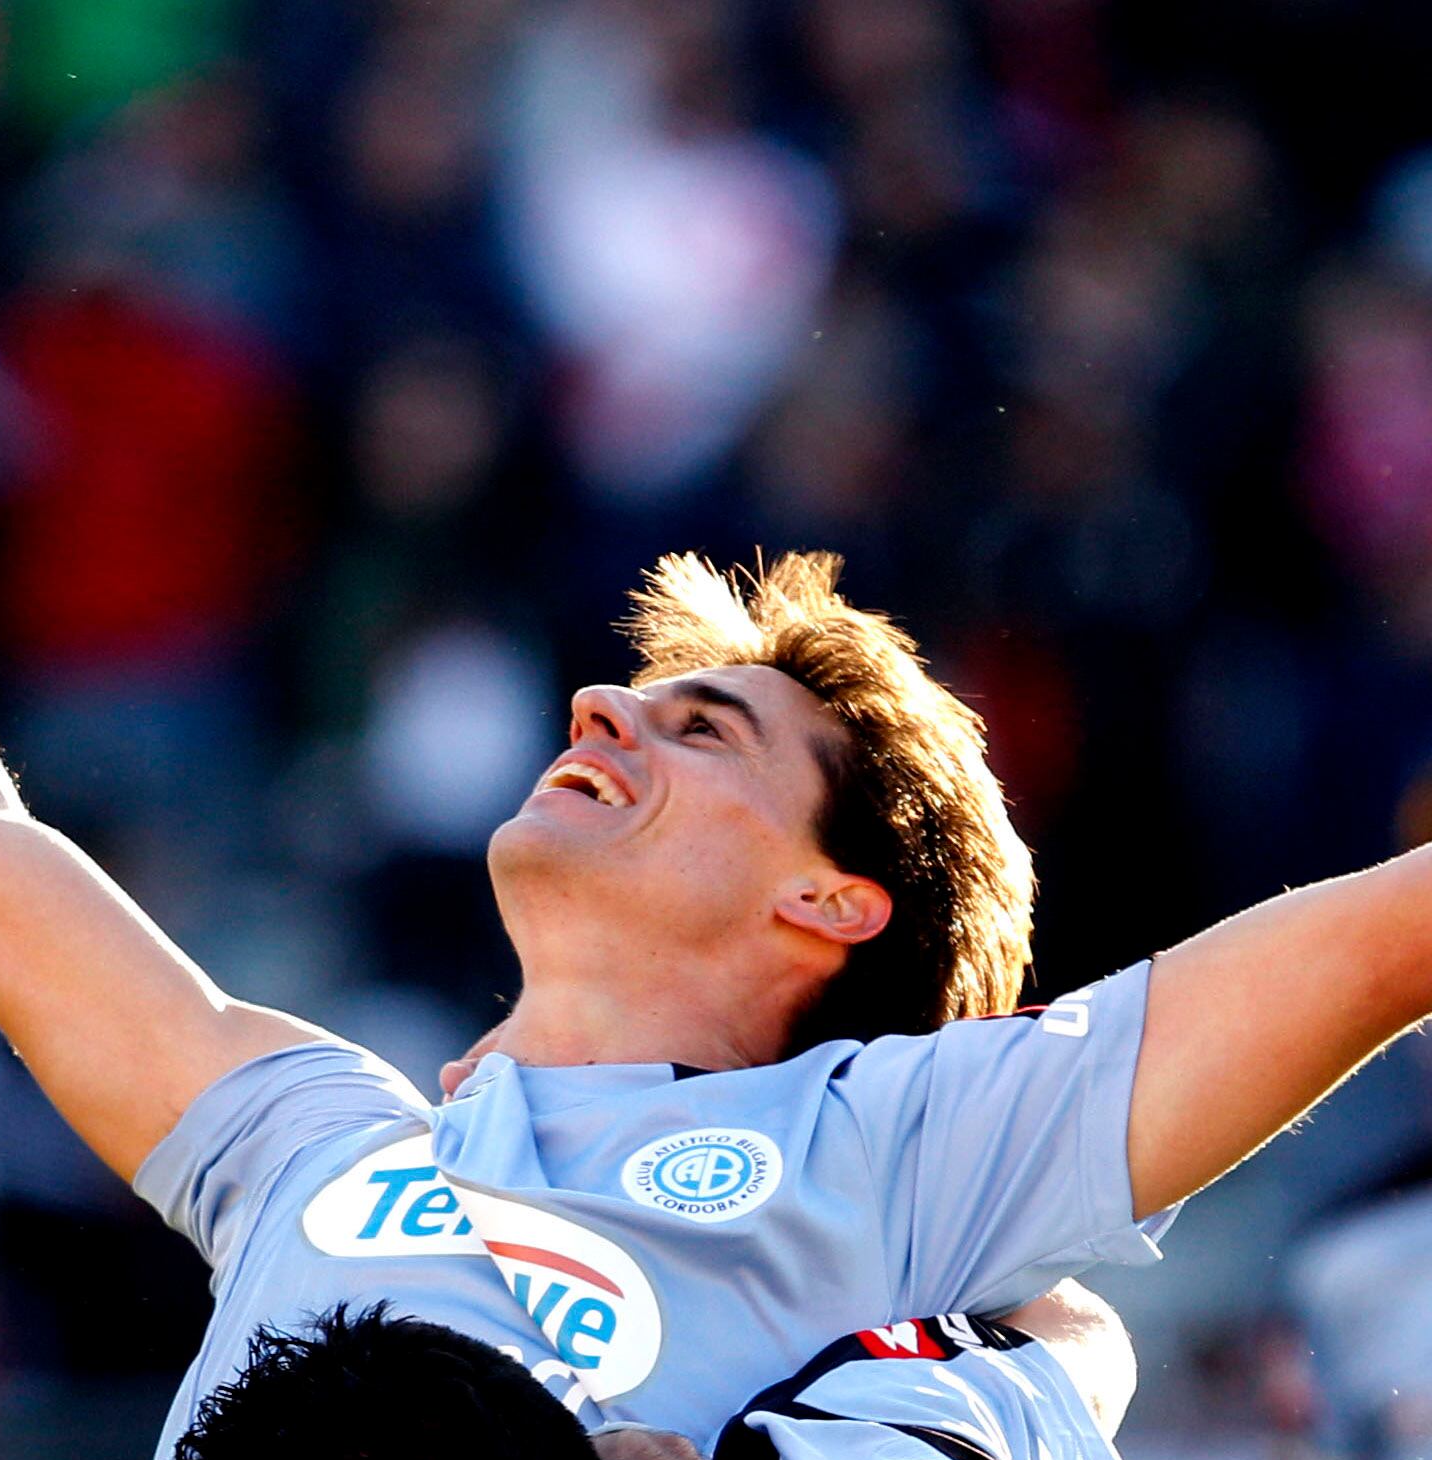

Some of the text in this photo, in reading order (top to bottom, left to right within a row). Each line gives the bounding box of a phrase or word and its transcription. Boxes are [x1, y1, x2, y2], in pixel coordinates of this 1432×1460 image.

[636, 1134, 768, 1194] CLUB ATLETICO BELGRANO
[653, 1194, 741, 1215] CORDOBA
